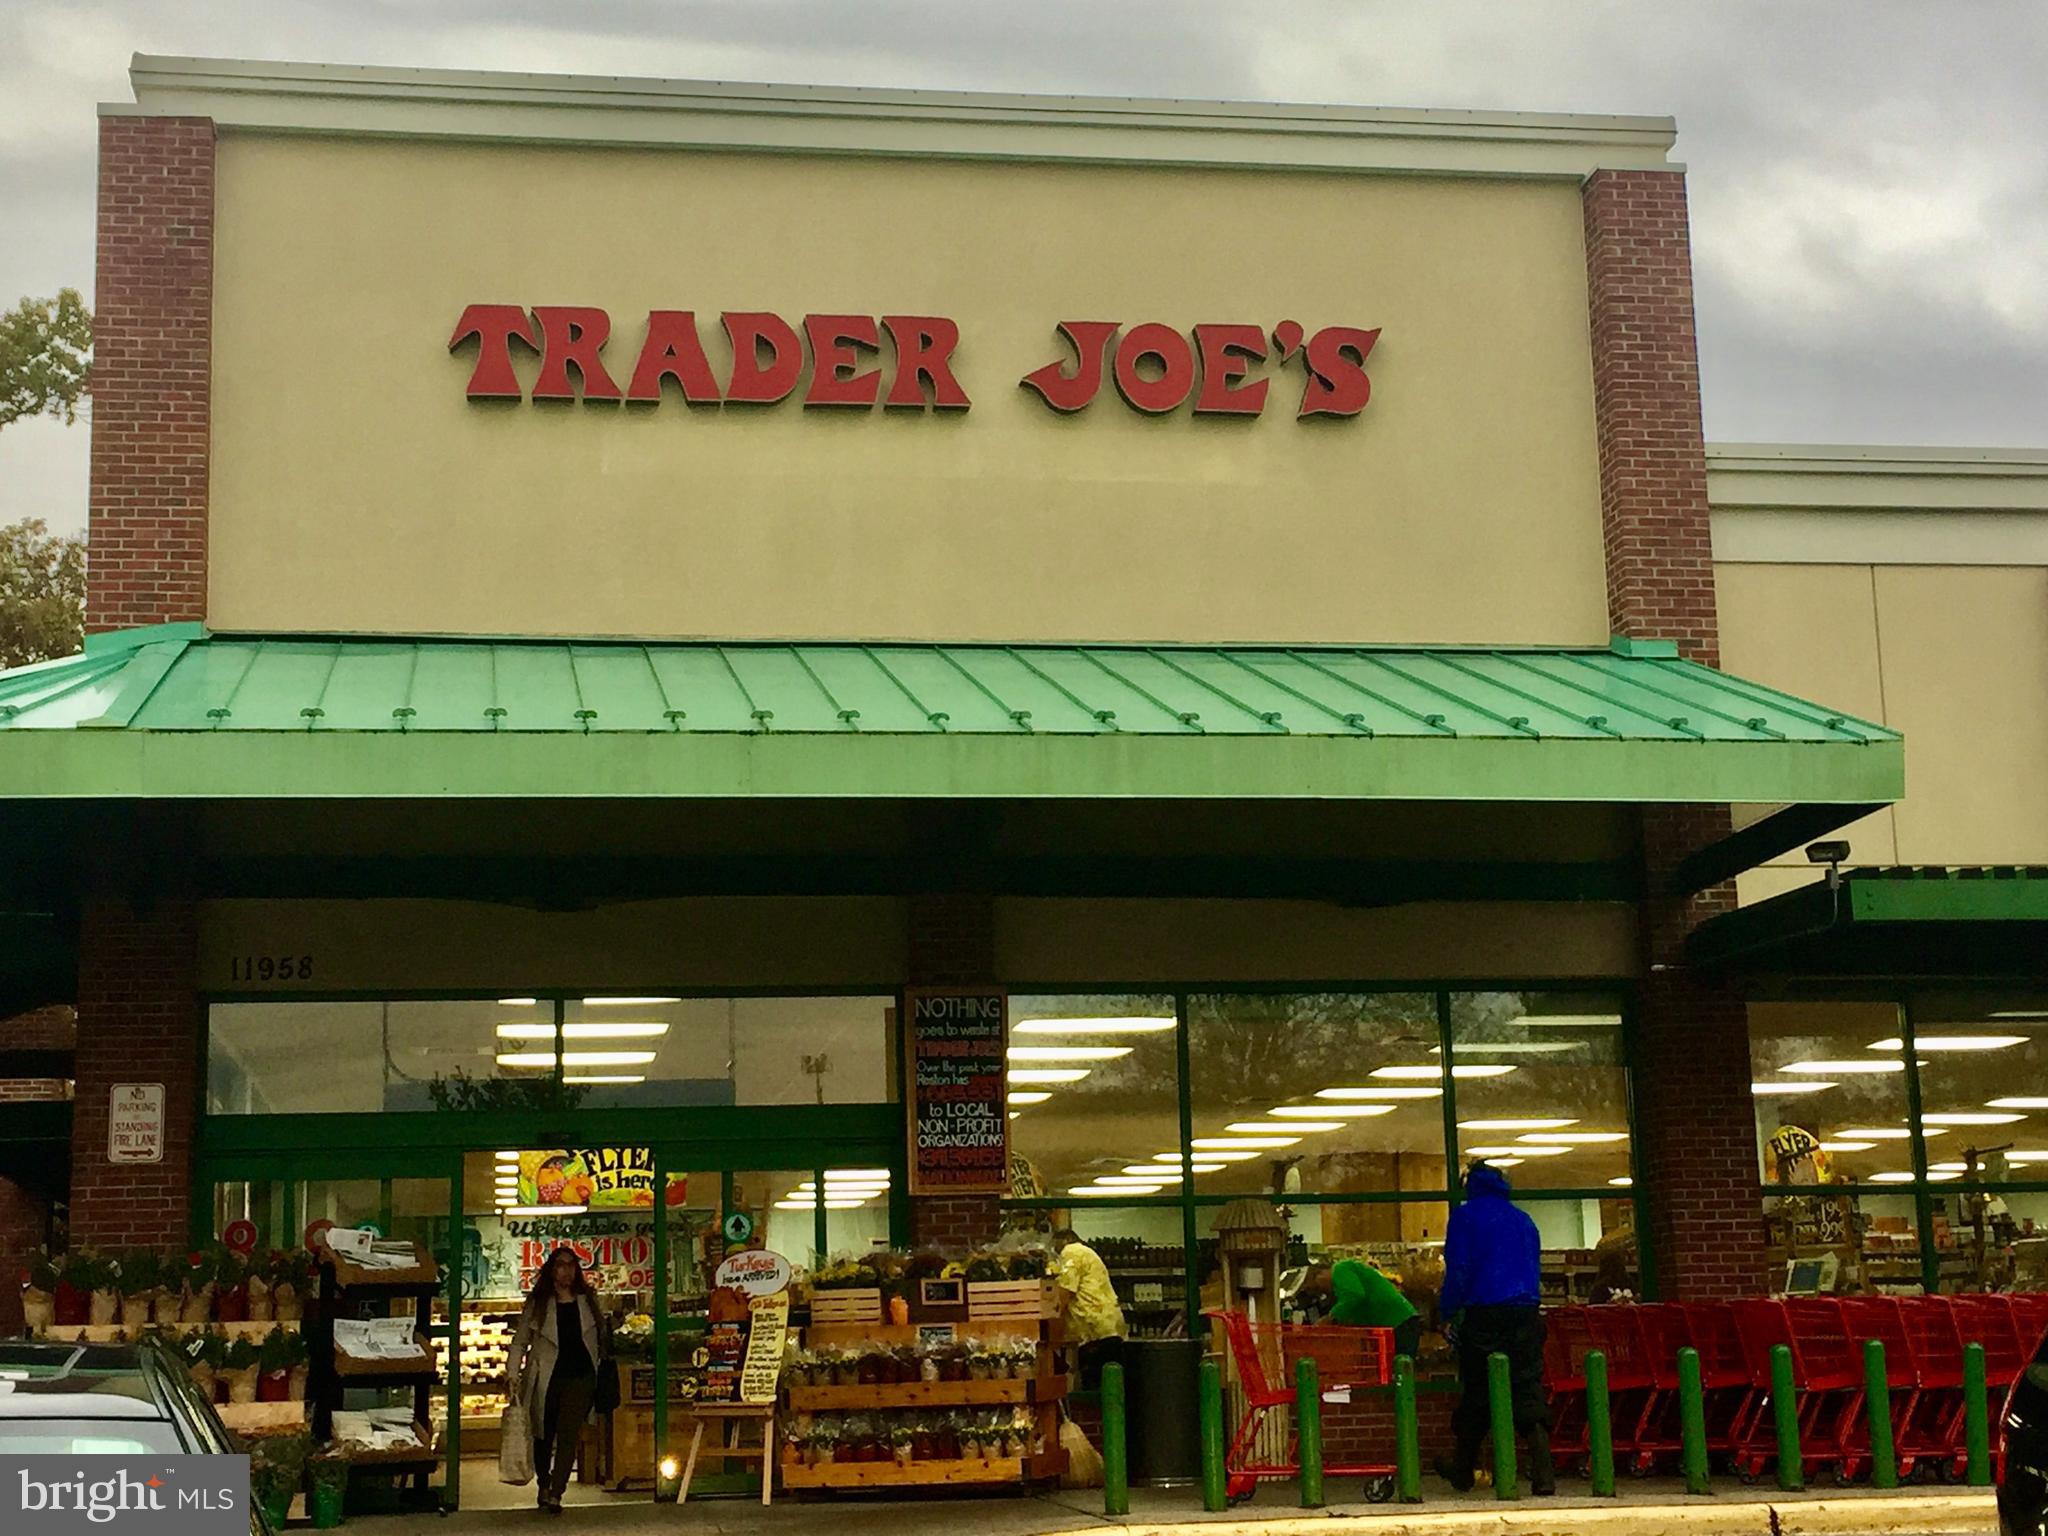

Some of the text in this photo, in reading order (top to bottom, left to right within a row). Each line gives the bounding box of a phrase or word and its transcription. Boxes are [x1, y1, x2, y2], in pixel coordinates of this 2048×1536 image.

[449, 303, 1382, 422] TRADER JOE'S
[232, 955, 313, 980] 11958
[915, 998, 1000, 1018] NOTHING
[946, 1021, 958, 1035] to
[917, 1060, 940, 1072] Over
[943, 1059, 956, 1072] the
[917, 1073, 950, 1086] Reston
[952, 1074, 969, 1085] has
[131, 1089, 145, 1100] NO
[118, 1103, 156, 1112] PARKING
[929, 1103, 994, 1117] to LOCAL
[115, 1121, 158, 1132] STANDING
[114, 1134, 156, 1146] FIRE LANE
[1770, 1132, 1812, 1154] FLYER
[596, 1176, 613, 1191] is
[507, 1219, 599, 1238] Welcome
[611, 1221, 631, 1234] to
